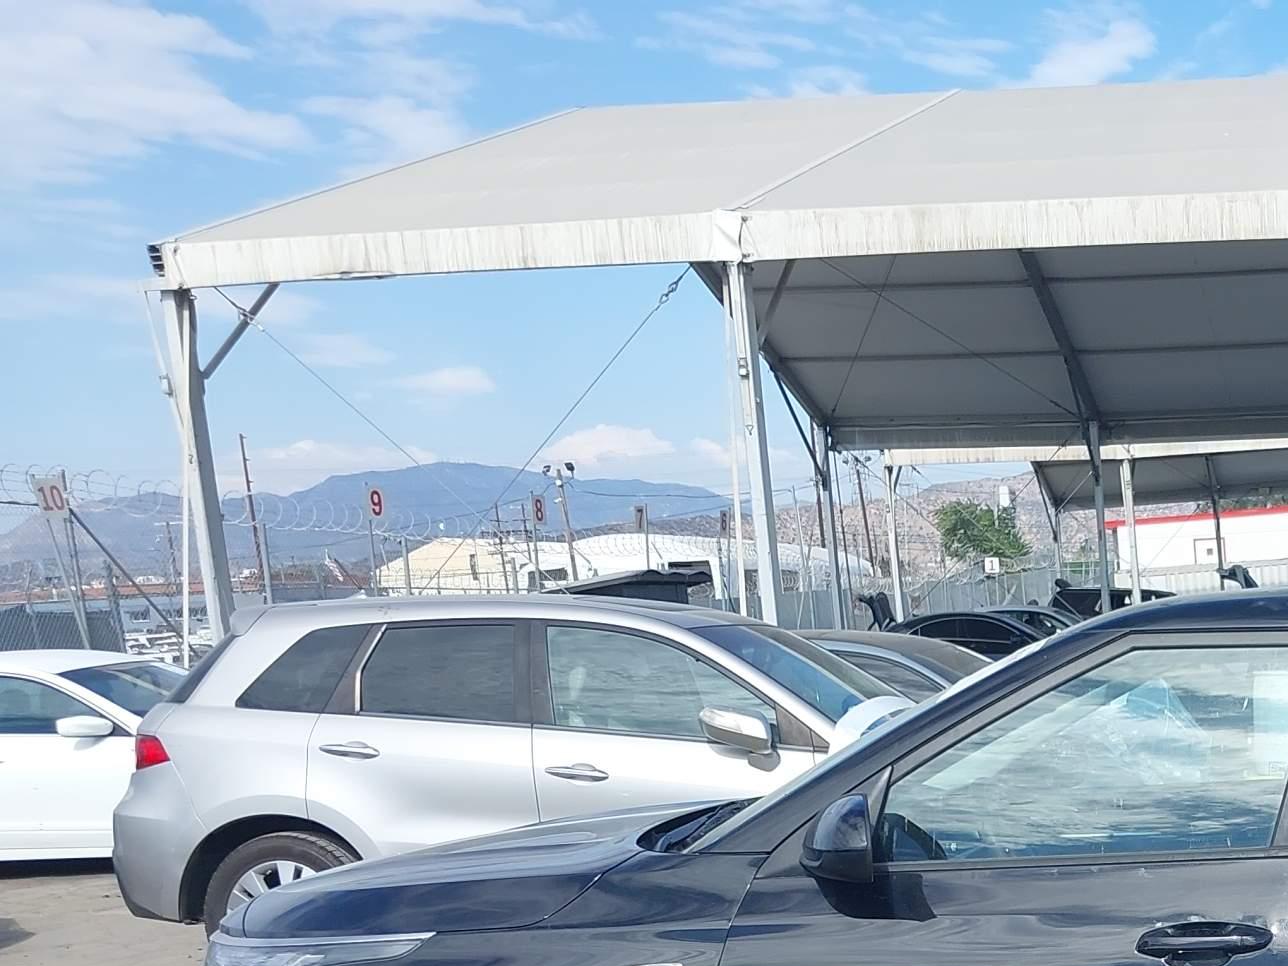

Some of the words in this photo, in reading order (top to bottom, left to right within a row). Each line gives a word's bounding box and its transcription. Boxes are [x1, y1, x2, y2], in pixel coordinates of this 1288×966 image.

[37, 485, 65, 511] 10
[370, 490, 382, 516] 9
[535, 498, 544, 522] 8
[636, 508, 644, 529] 7
[989, 559, 996, 571] 1
